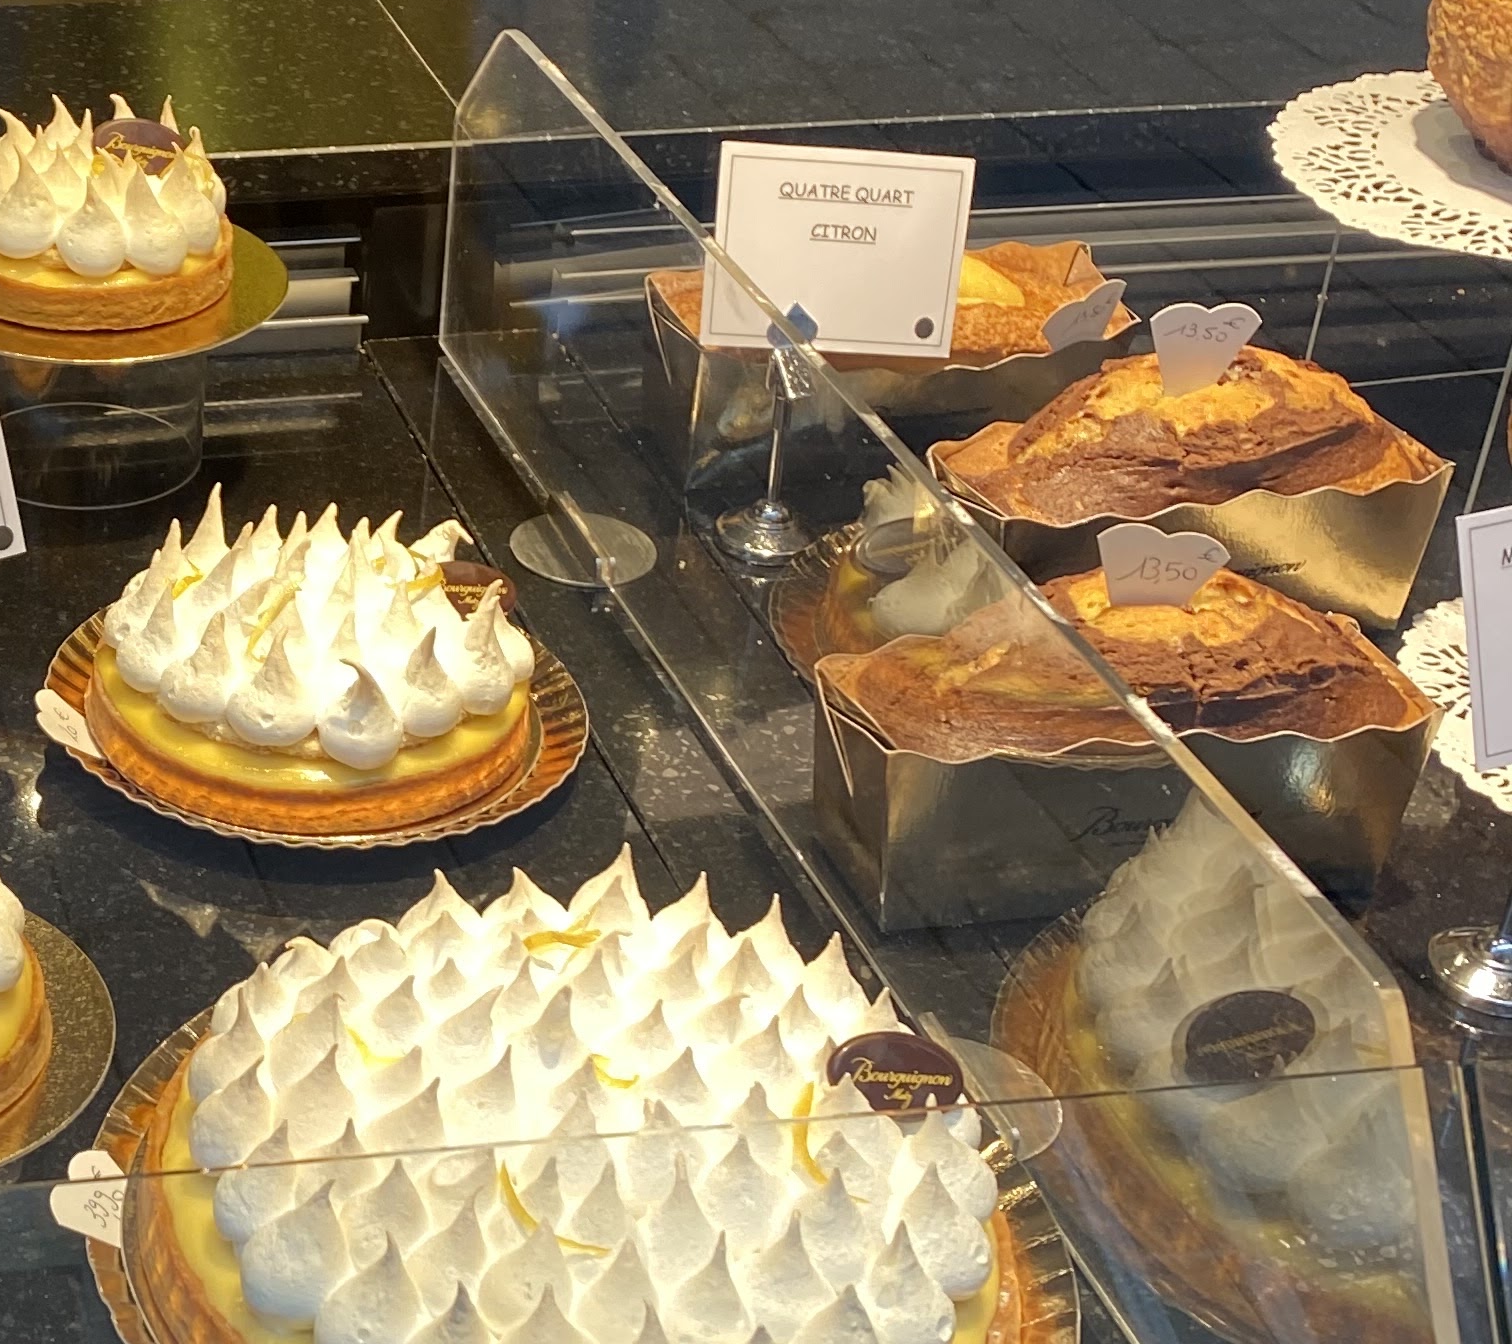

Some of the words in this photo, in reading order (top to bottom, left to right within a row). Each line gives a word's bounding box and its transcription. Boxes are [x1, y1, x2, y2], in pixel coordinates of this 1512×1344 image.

[104, 131, 176, 160] Bourguigno
[779, 181, 851, 200] QUATRE
[855, 187, 914, 205] QUART
[810, 223, 877, 242] CITRON
[850, 1057, 953, 1090] Bourguignon
